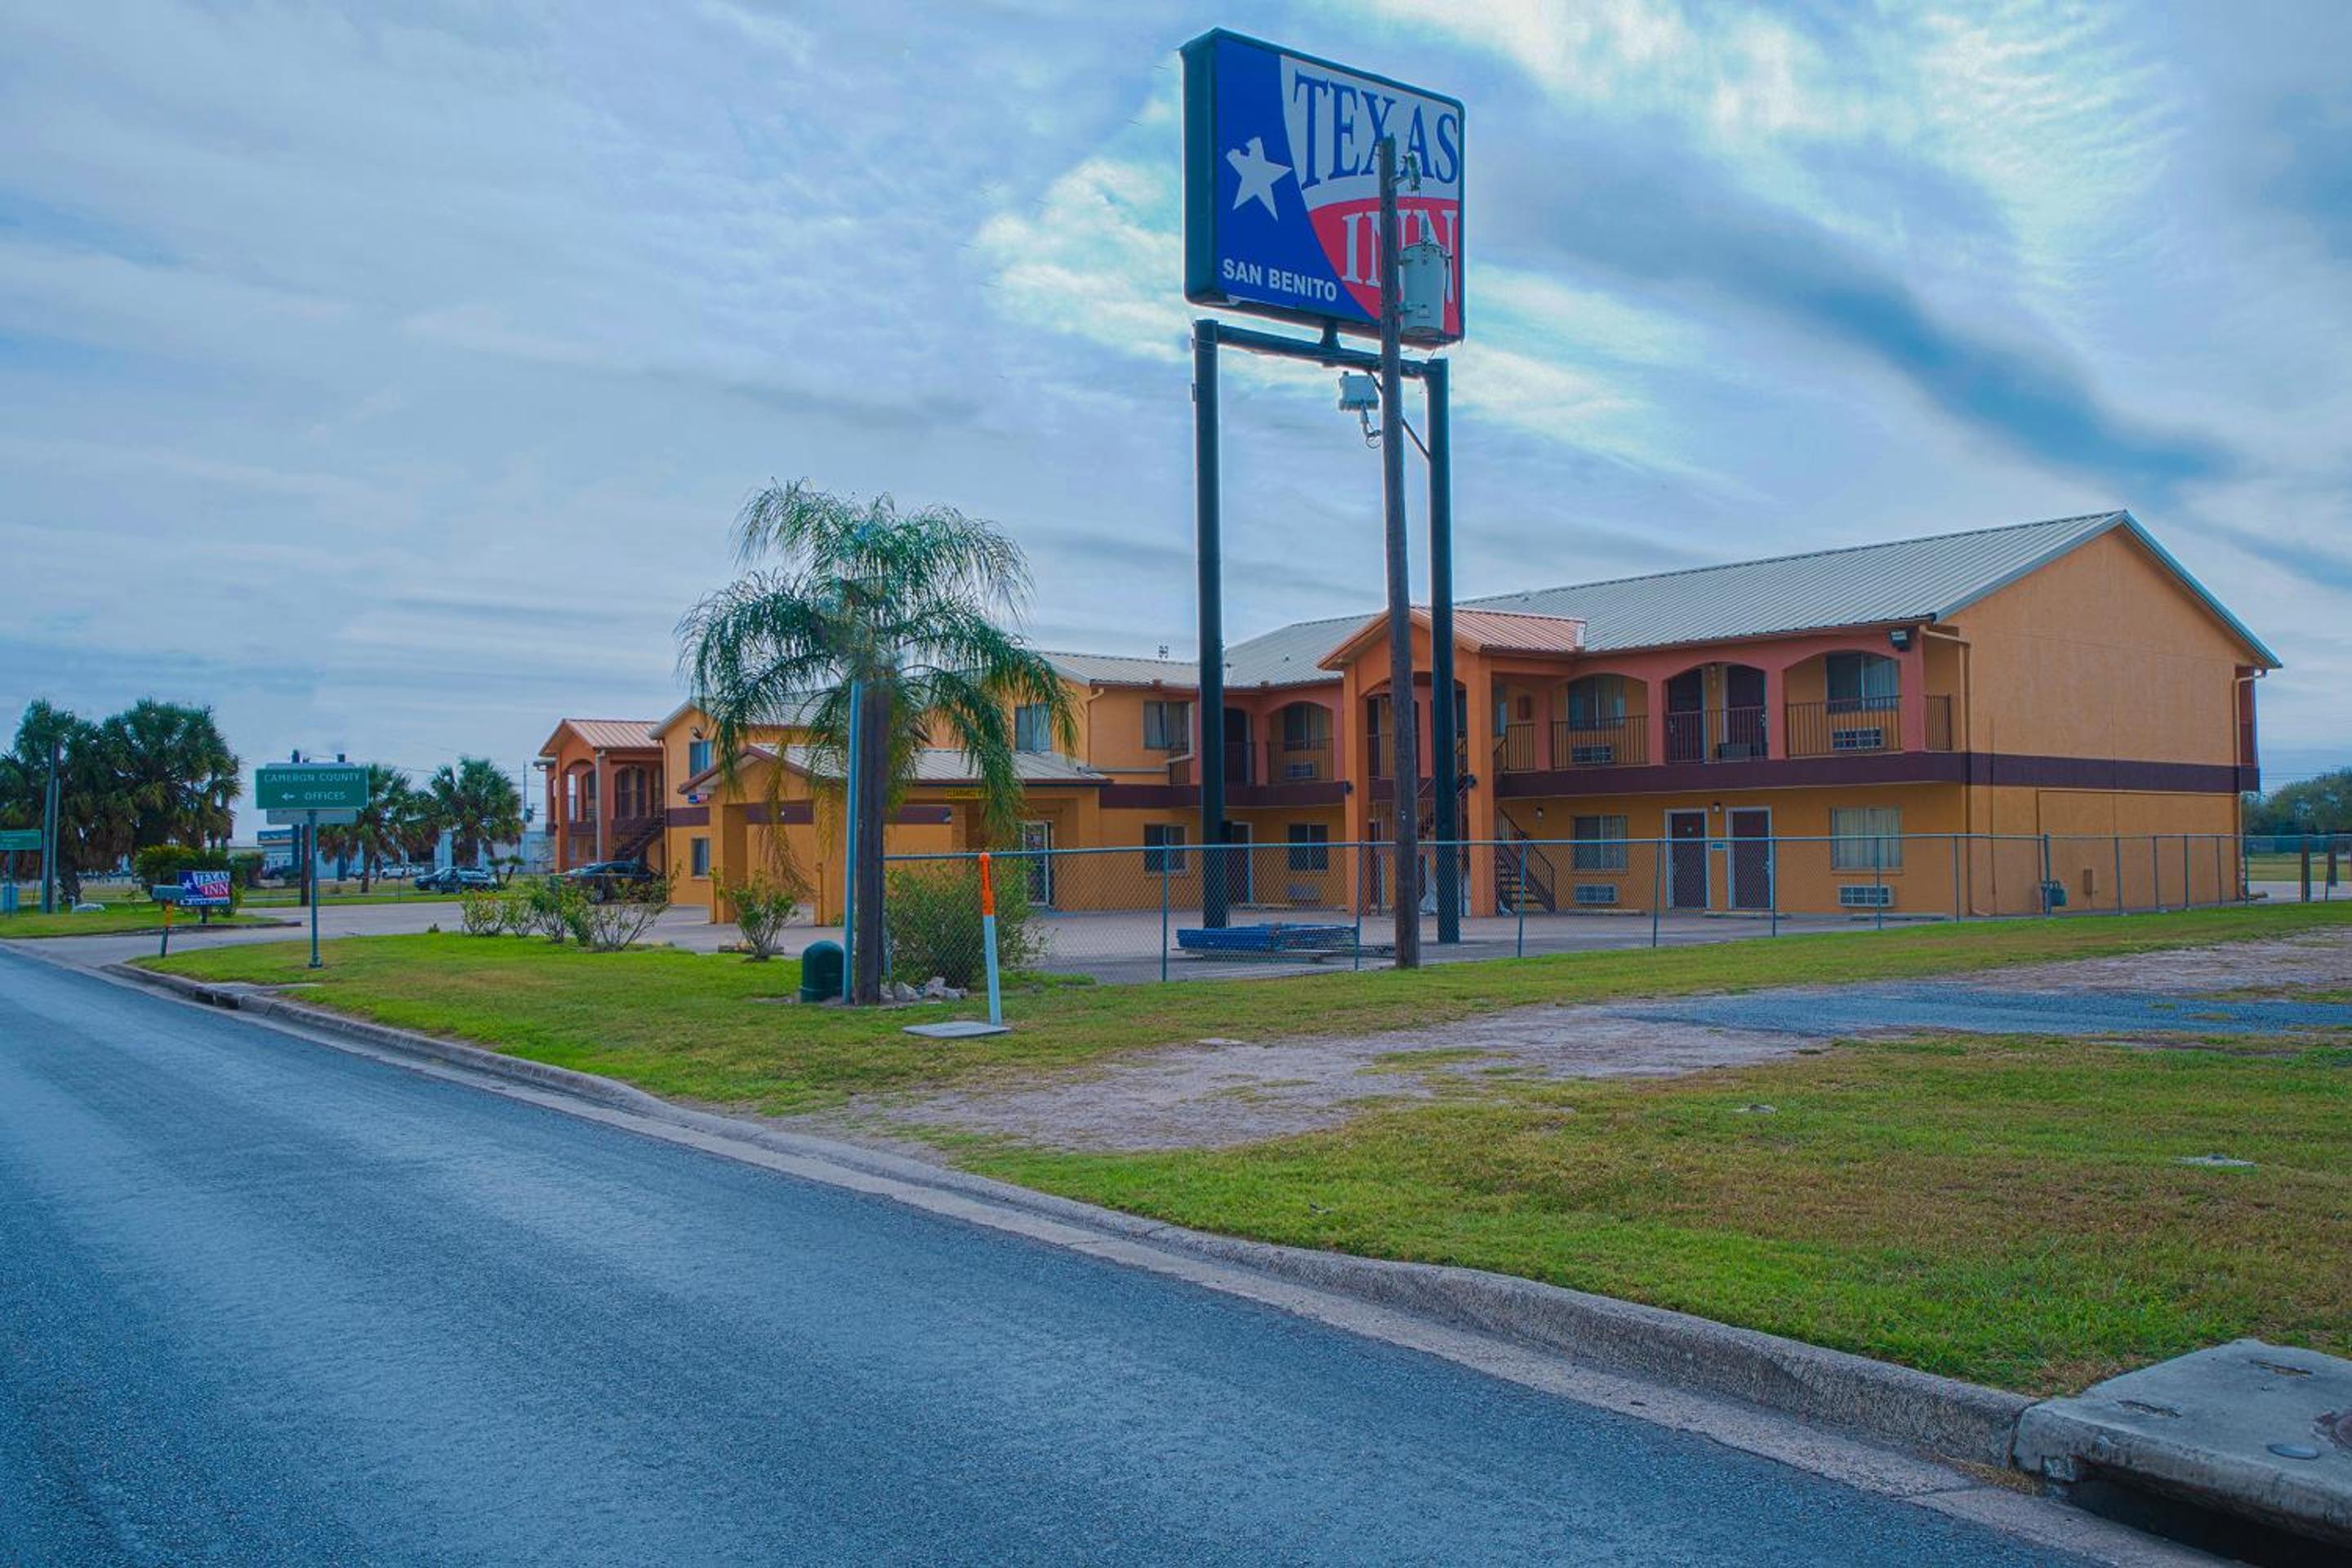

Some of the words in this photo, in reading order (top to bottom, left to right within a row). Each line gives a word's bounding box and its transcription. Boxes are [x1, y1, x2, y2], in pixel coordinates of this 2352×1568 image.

[1294, 69, 1458, 189] TEXAS
[1223, 258, 1262, 286] SAN
[1268, 267, 1337, 302] BENITO
[264, 773, 315, 782] CAMERON
[319, 772, 360, 782] COUNTY
[305, 791, 346, 800] OFFICES
[196, 871, 229, 886] TEXAS
[204, 882, 229, 895] INN
